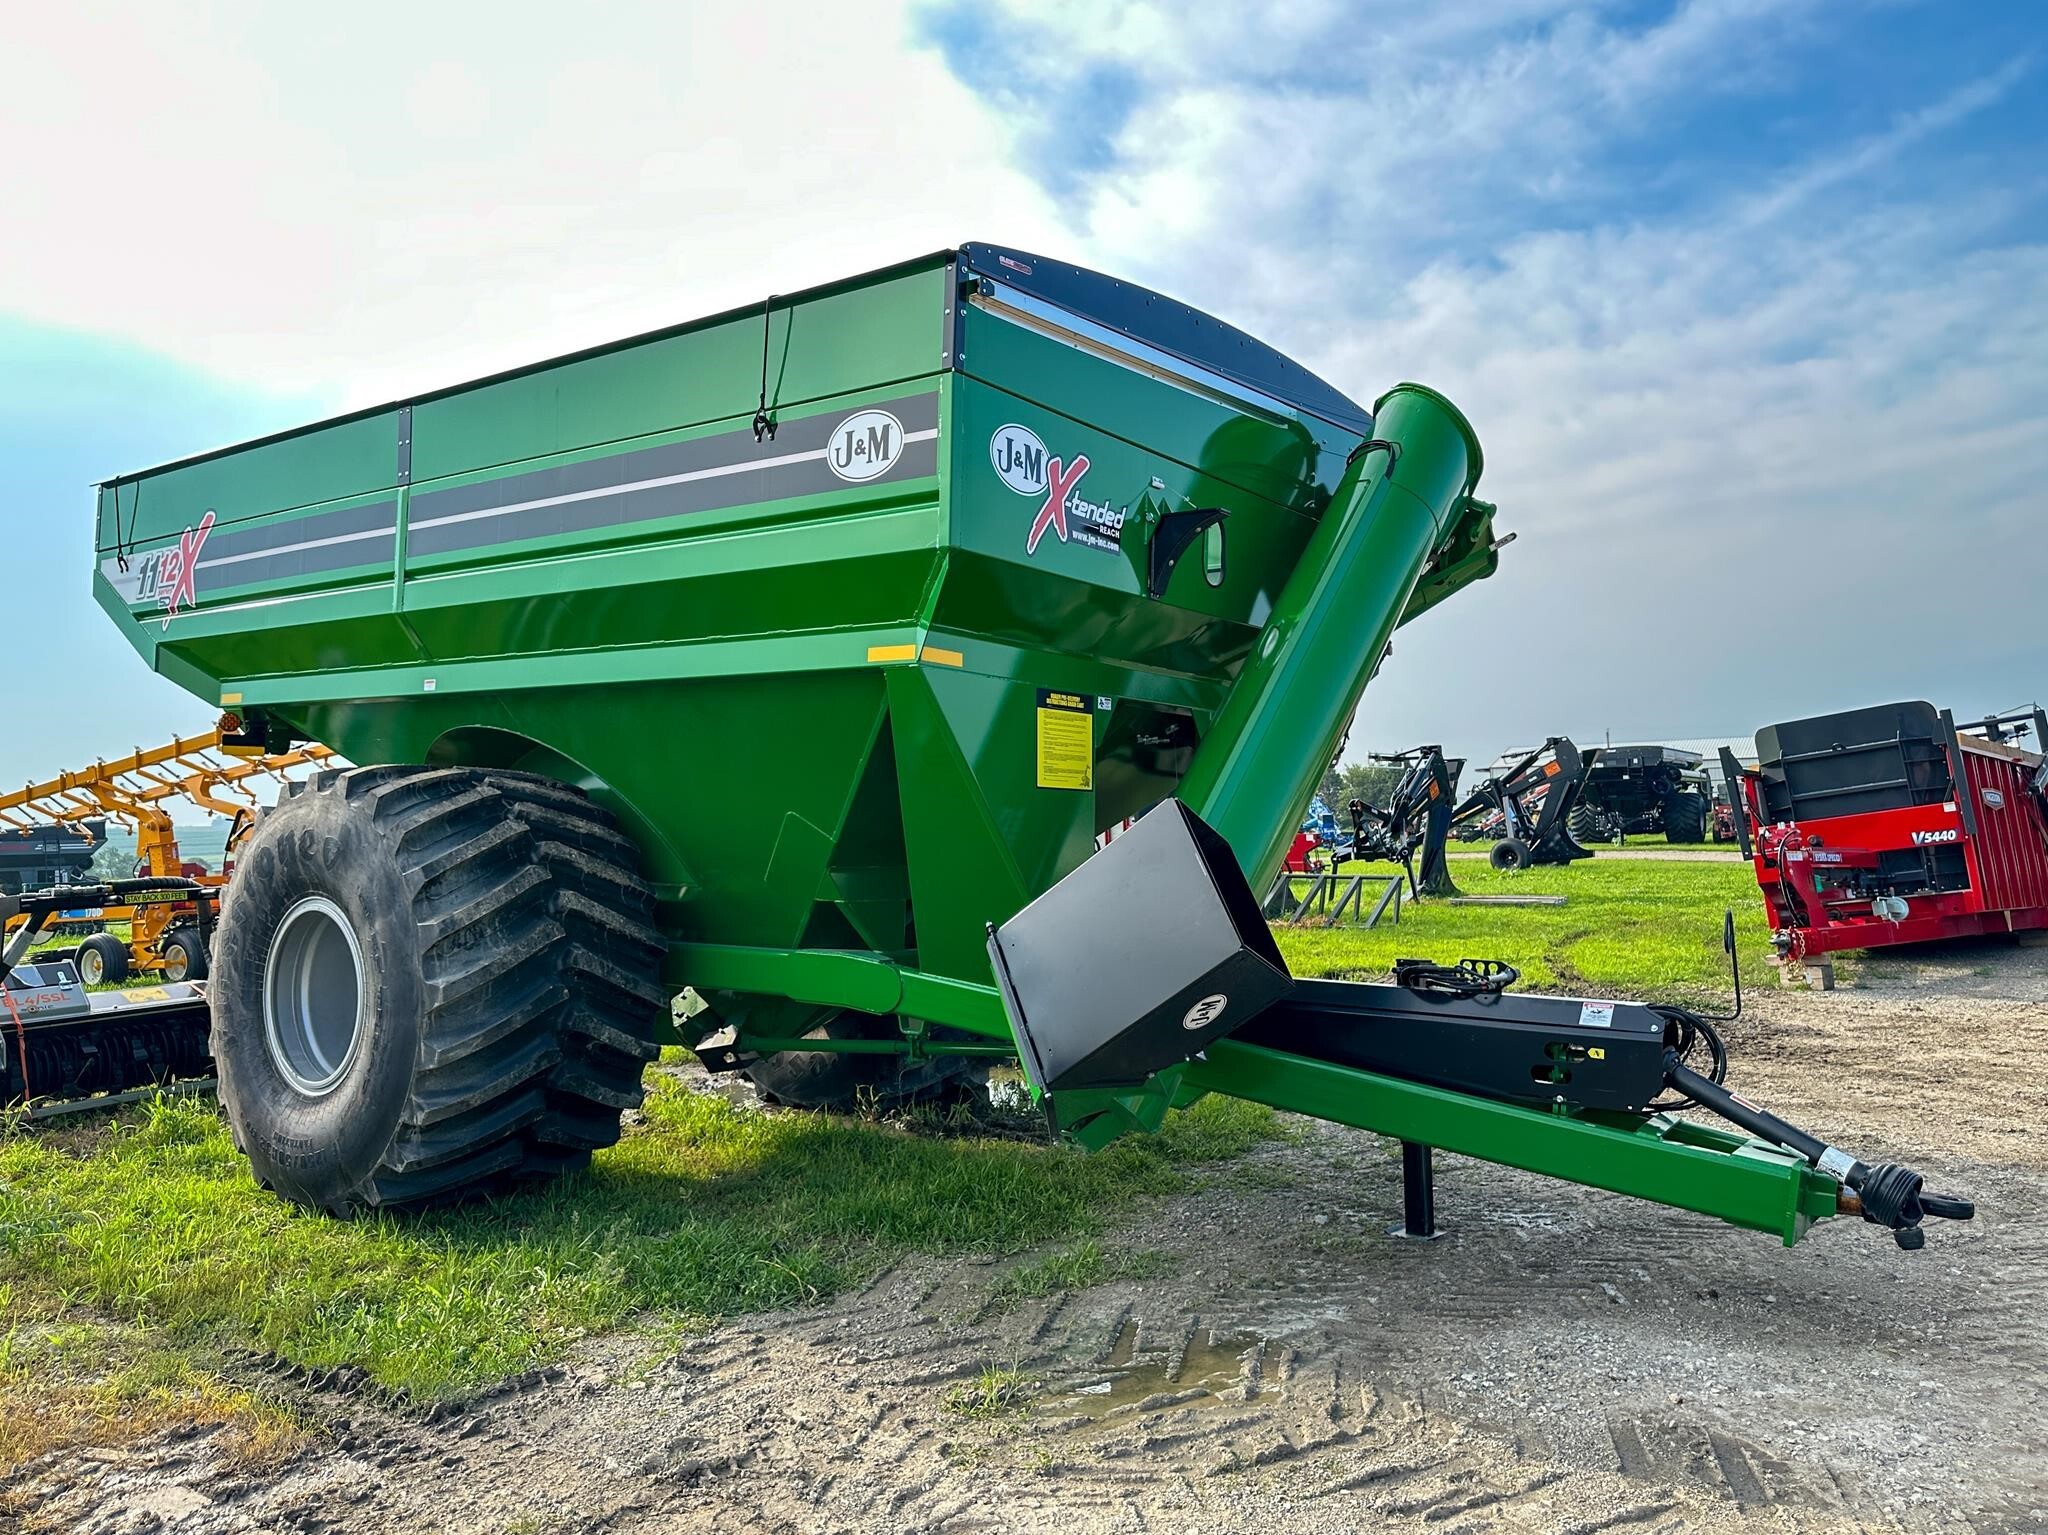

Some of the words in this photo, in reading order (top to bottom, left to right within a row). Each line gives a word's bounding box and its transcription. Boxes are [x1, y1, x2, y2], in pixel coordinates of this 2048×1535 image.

[835, 423, 891, 469] J&M
[996, 436, 1043, 485] J&M
[1099, 525, 1120, 538] REACH
[1911, 829, 1957, 846] V5440
[126, 895, 141, 903] STAY
[141, 893, 159, 902] BACK
[170, 890, 186, 900] FEET
